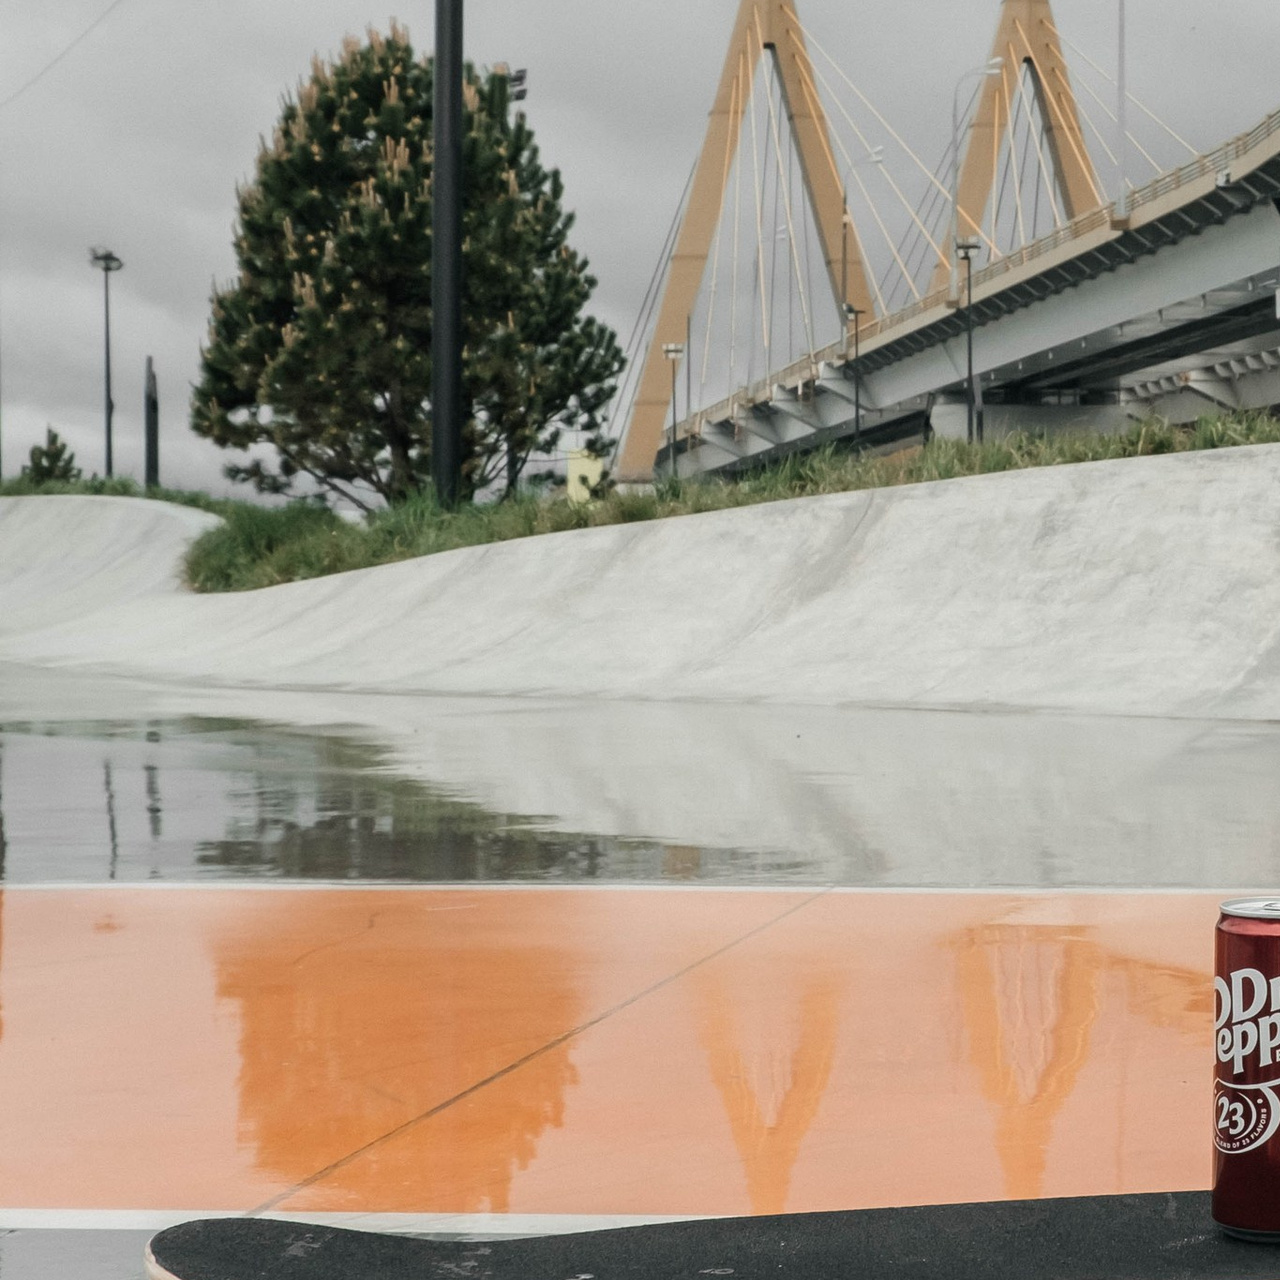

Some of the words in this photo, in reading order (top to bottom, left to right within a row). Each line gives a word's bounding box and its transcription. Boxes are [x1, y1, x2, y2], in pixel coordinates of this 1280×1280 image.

[1218, 1096, 1245, 1135] 23
[1232, 1141, 1240, 1149] OF
[1250, 1108, 1267, 1140] FLAVORS
